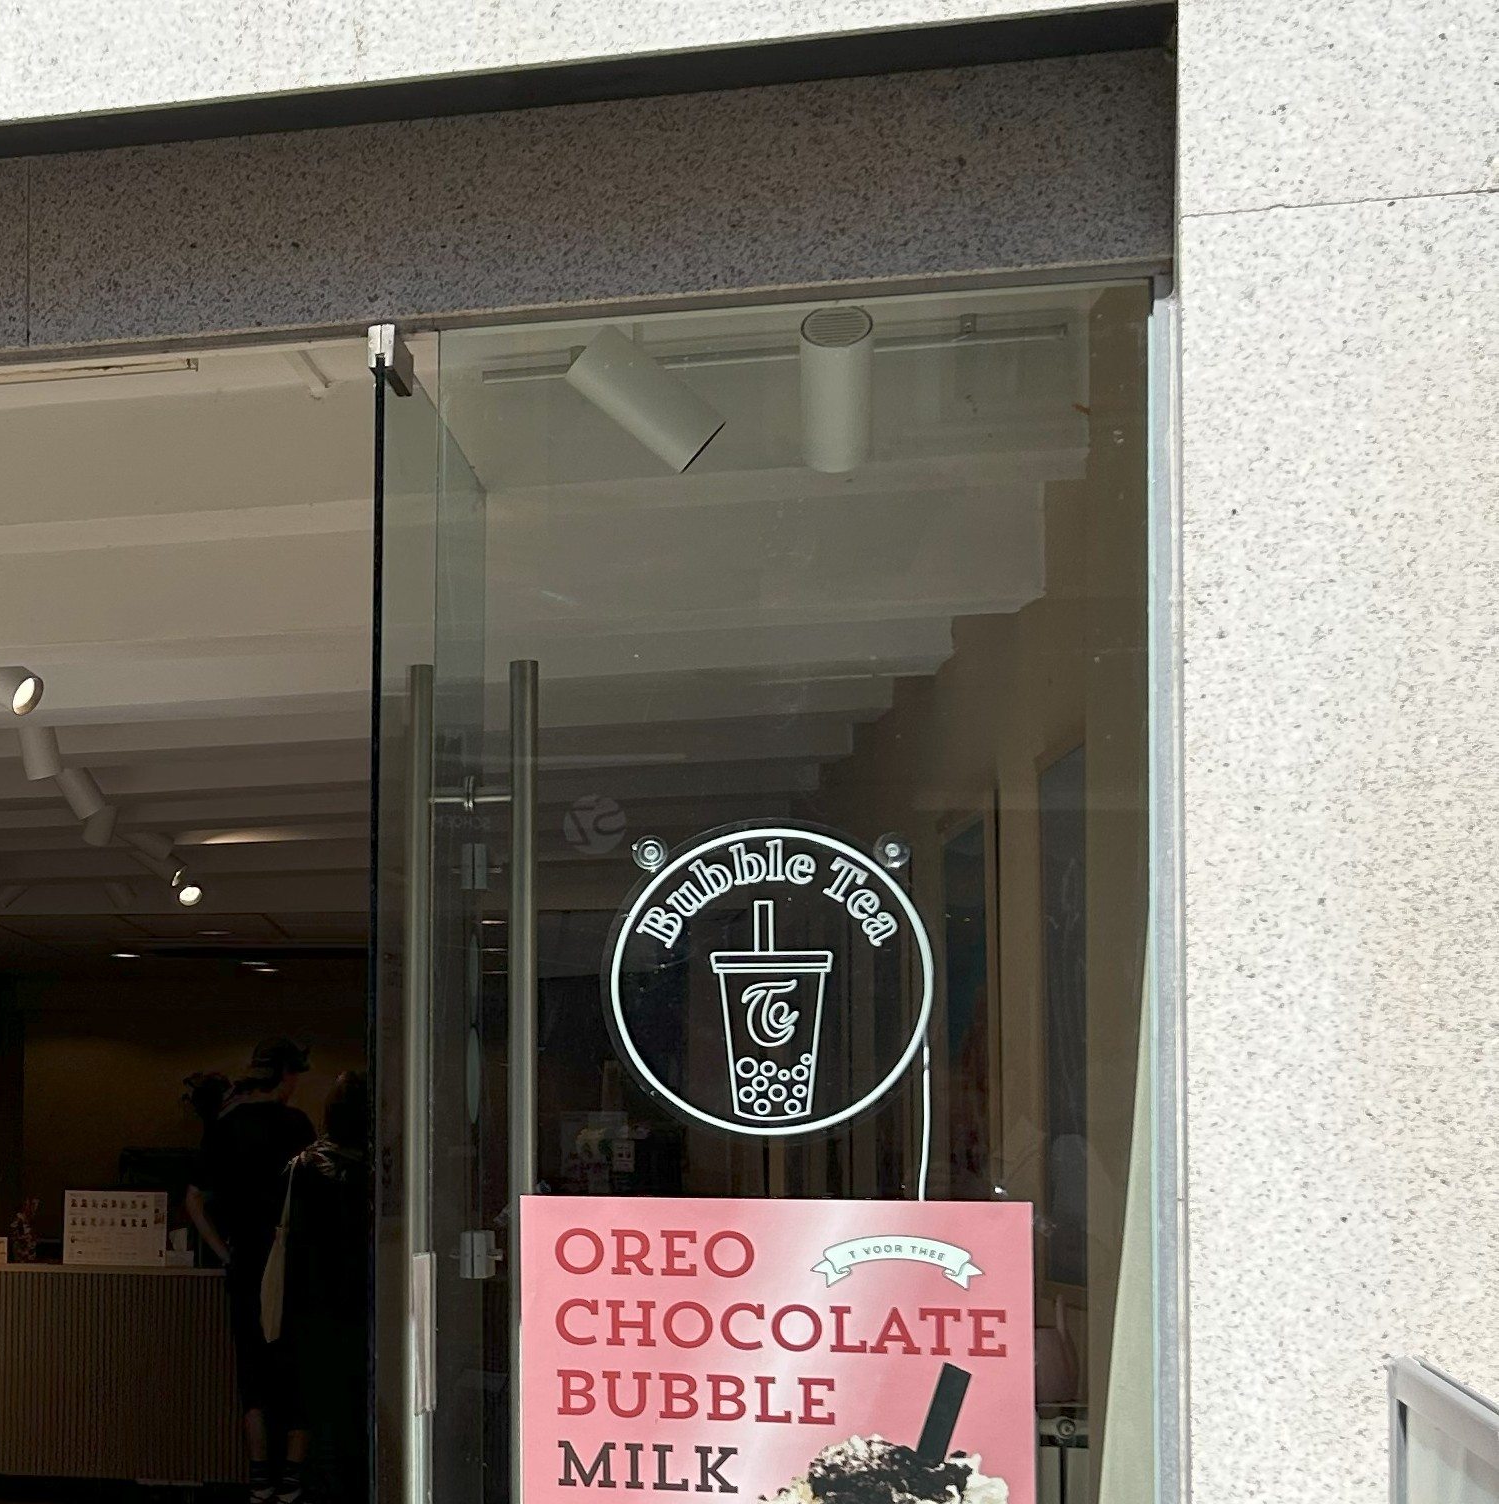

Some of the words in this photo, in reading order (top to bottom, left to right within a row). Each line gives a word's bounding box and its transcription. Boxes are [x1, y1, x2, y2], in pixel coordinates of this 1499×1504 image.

[636, 839, 817, 949] Bubble
[822, 856, 899, 948] Tea
[555, 1227, 756, 1279] OREO
[848, 1250, 857, 1259] T
[862, 1244, 903, 1255] VOOR
[910, 1245, 946, 1262] THEE
[554, 1299, 1008, 1358] CHOCOLATE
[556, 1369, 837, 1425] BUBBLE
[557, 1440, 740, 1495] MILK
